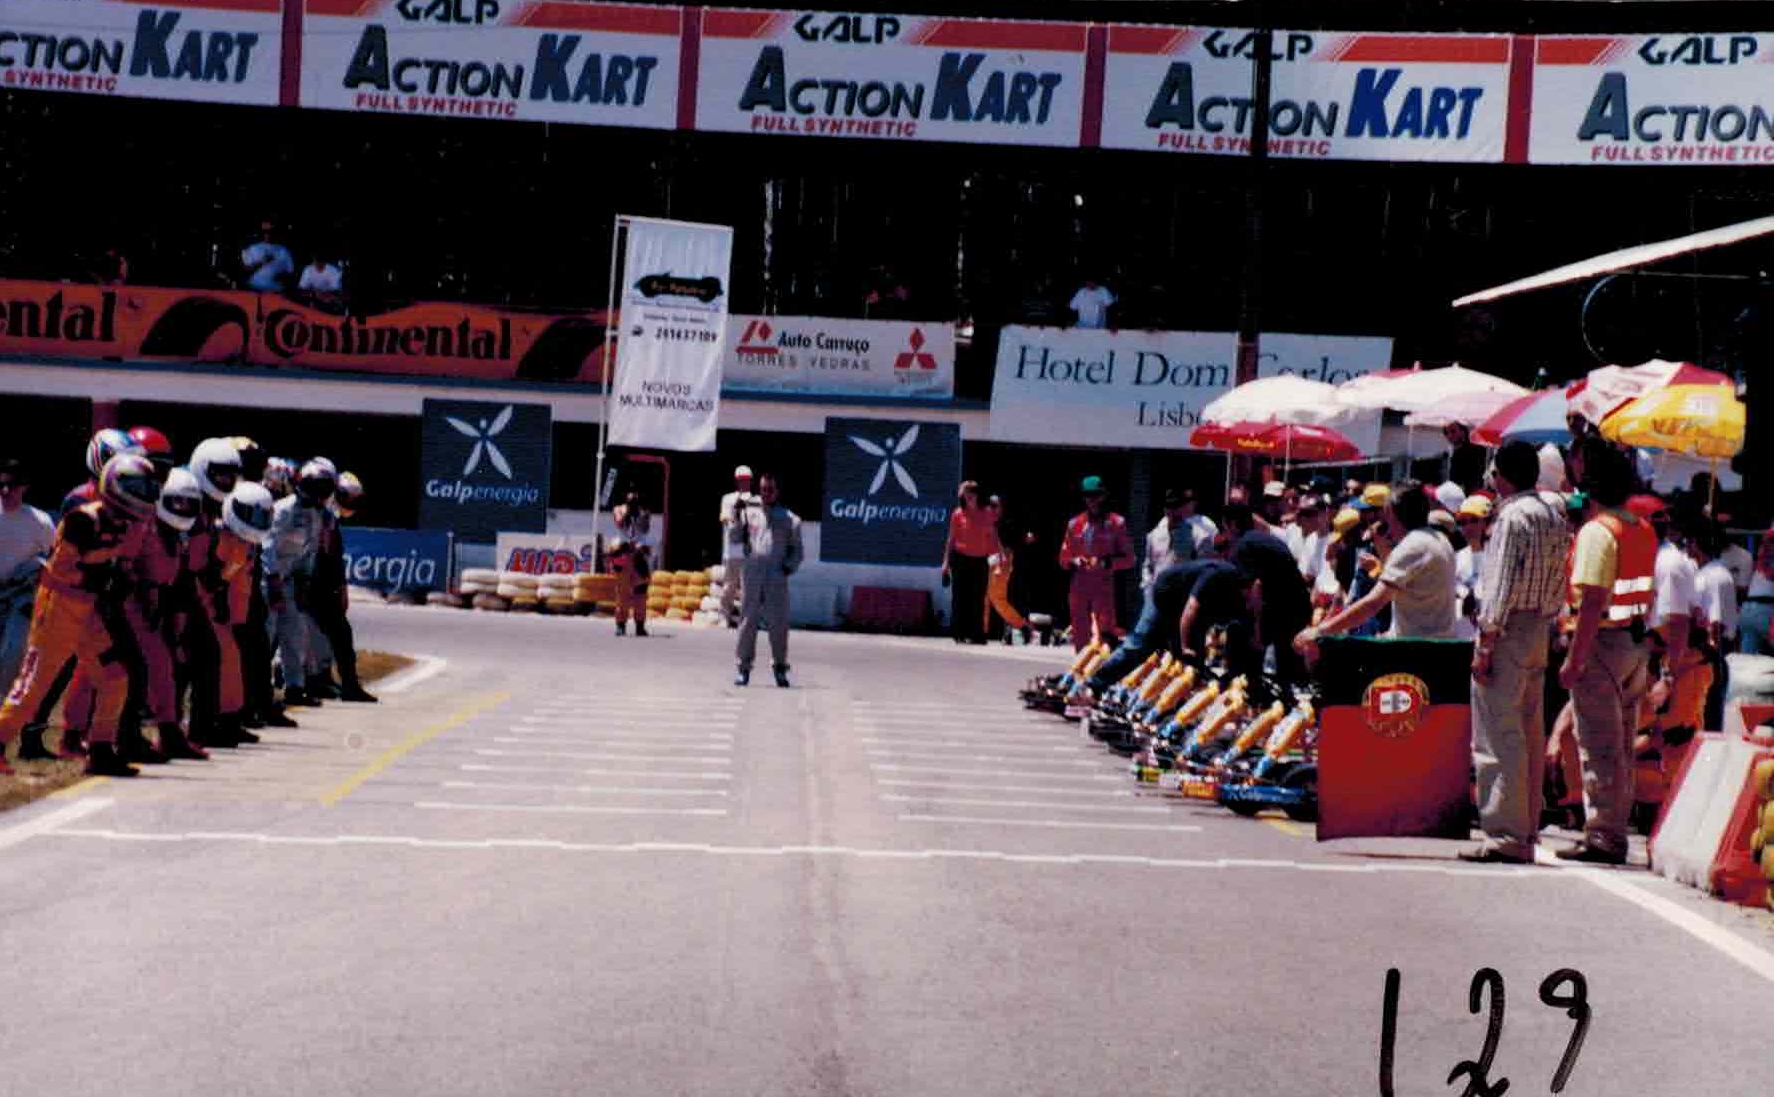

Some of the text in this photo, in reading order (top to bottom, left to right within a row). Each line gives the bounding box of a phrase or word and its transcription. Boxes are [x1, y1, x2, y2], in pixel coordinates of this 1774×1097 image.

[396, 0, 500, 25] GALP
[794, 13, 901, 44] GALP
[129, 9, 259, 84] KART
[1638, 36, 1758, 66] GALP
[341, 24, 658, 106] ACTION KART
[4, 69, 118, 91] SYNTHETIC
[738, 45, 1062, 125] ACTION KART
[354, 93, 518, 117] FULL SYNTHETIC
[1145, 61, 1484, 139] ACTON KART
[750, 116, 917, 138] FULL SYNTHETIC
[1157, 132, 1332, 155] FULL SYNHETIC
[1590, 145, 1645, 161] FULL
[0, 289, 117, 342] ntal
[263, 308, 511, 360] Continental
[777, 330, 812, 350] Auto
[736, 353, 872, 372] TORRES VEDRAS
[1015, 345, 1116, 386] Hotel
[1132, 351, 1230, 387] Dom
[642, 380, 692, 395] NOVOS
[1138, 400, 1201, 426] Lisb
[425, 477, 540, 506] Galpenergia
[829, 498, 949, 529] Galpenergia
[342, 548, 436, 595] nergia
